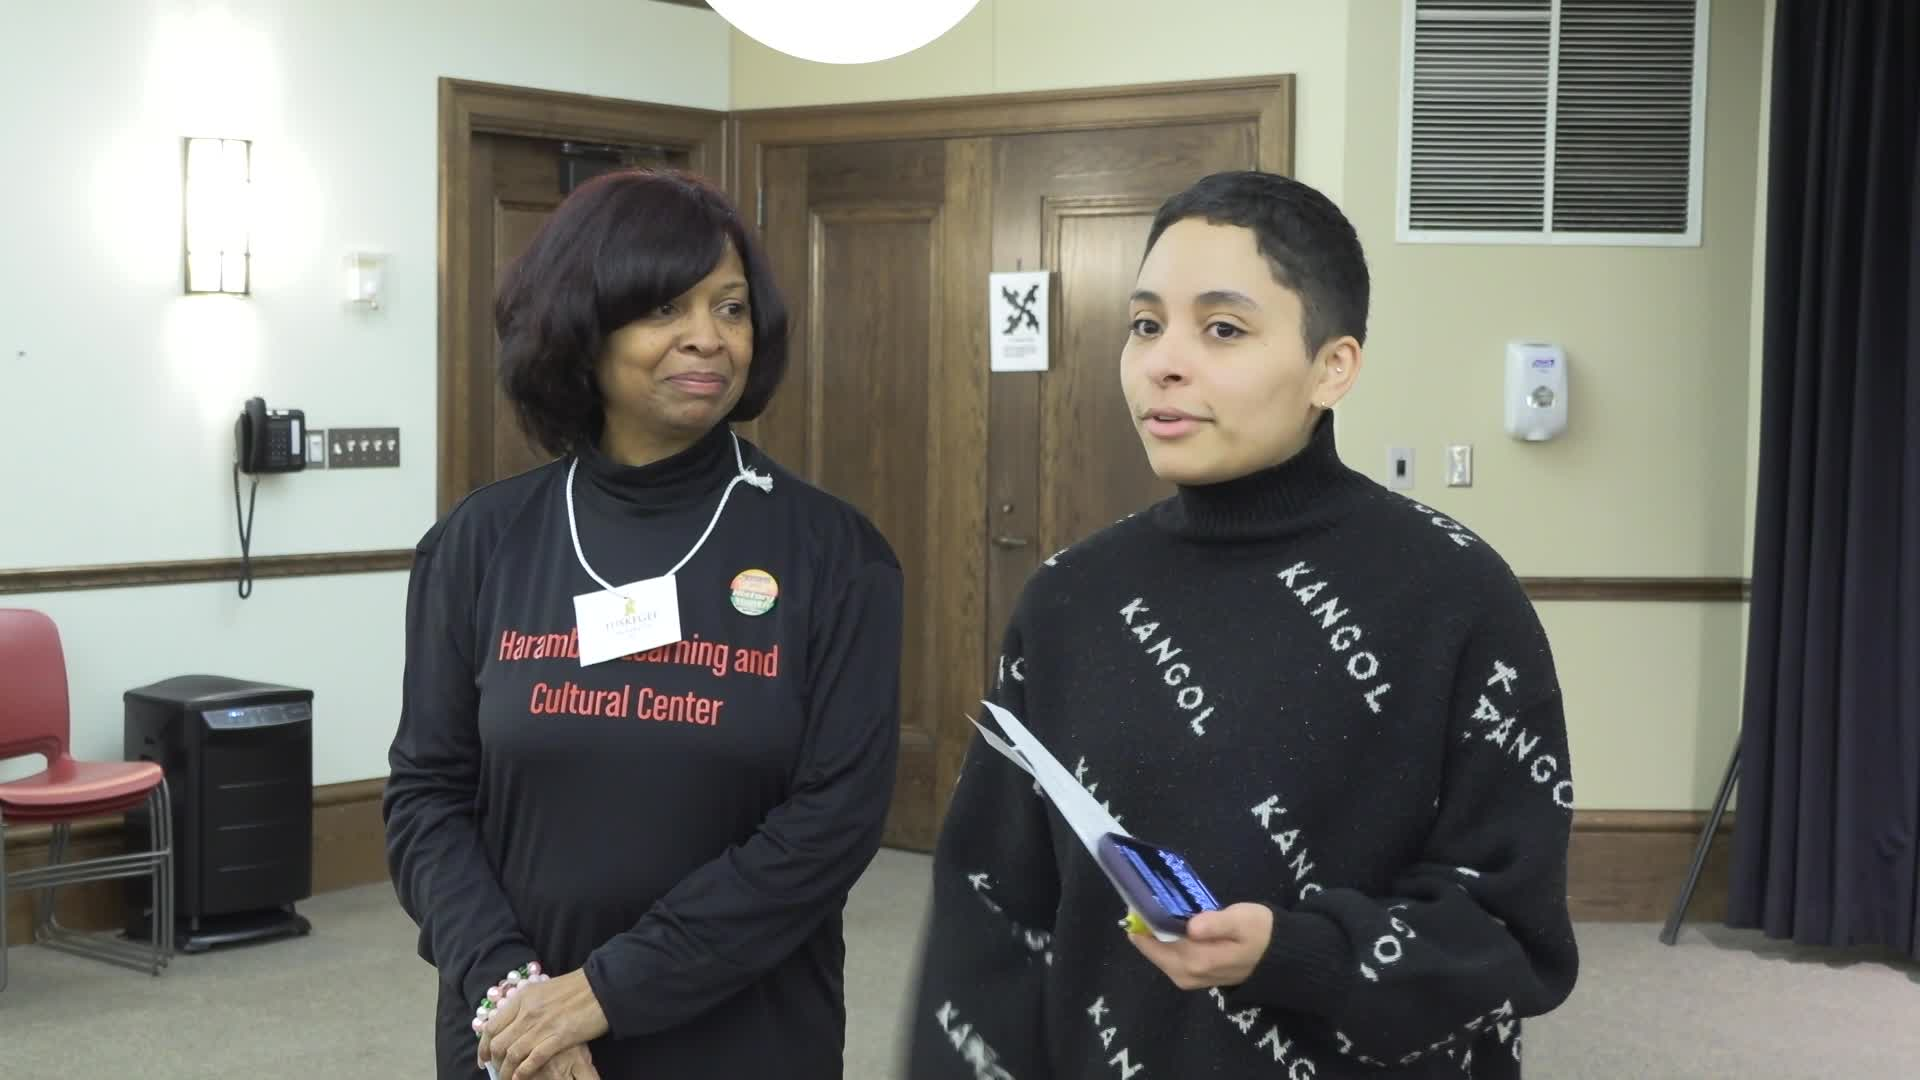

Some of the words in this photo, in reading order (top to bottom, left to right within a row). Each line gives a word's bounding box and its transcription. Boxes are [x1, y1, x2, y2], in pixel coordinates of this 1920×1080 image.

[499, 627, 581, 661] Haramb
[734, 645, 778, 677] and
[1120, 597, 1214, 736] KANGOL
[1278, 560, 1392, 714] KANGOL
[530, 681, 630, 718] Cultural
[637, 687, 724, 726] Center
